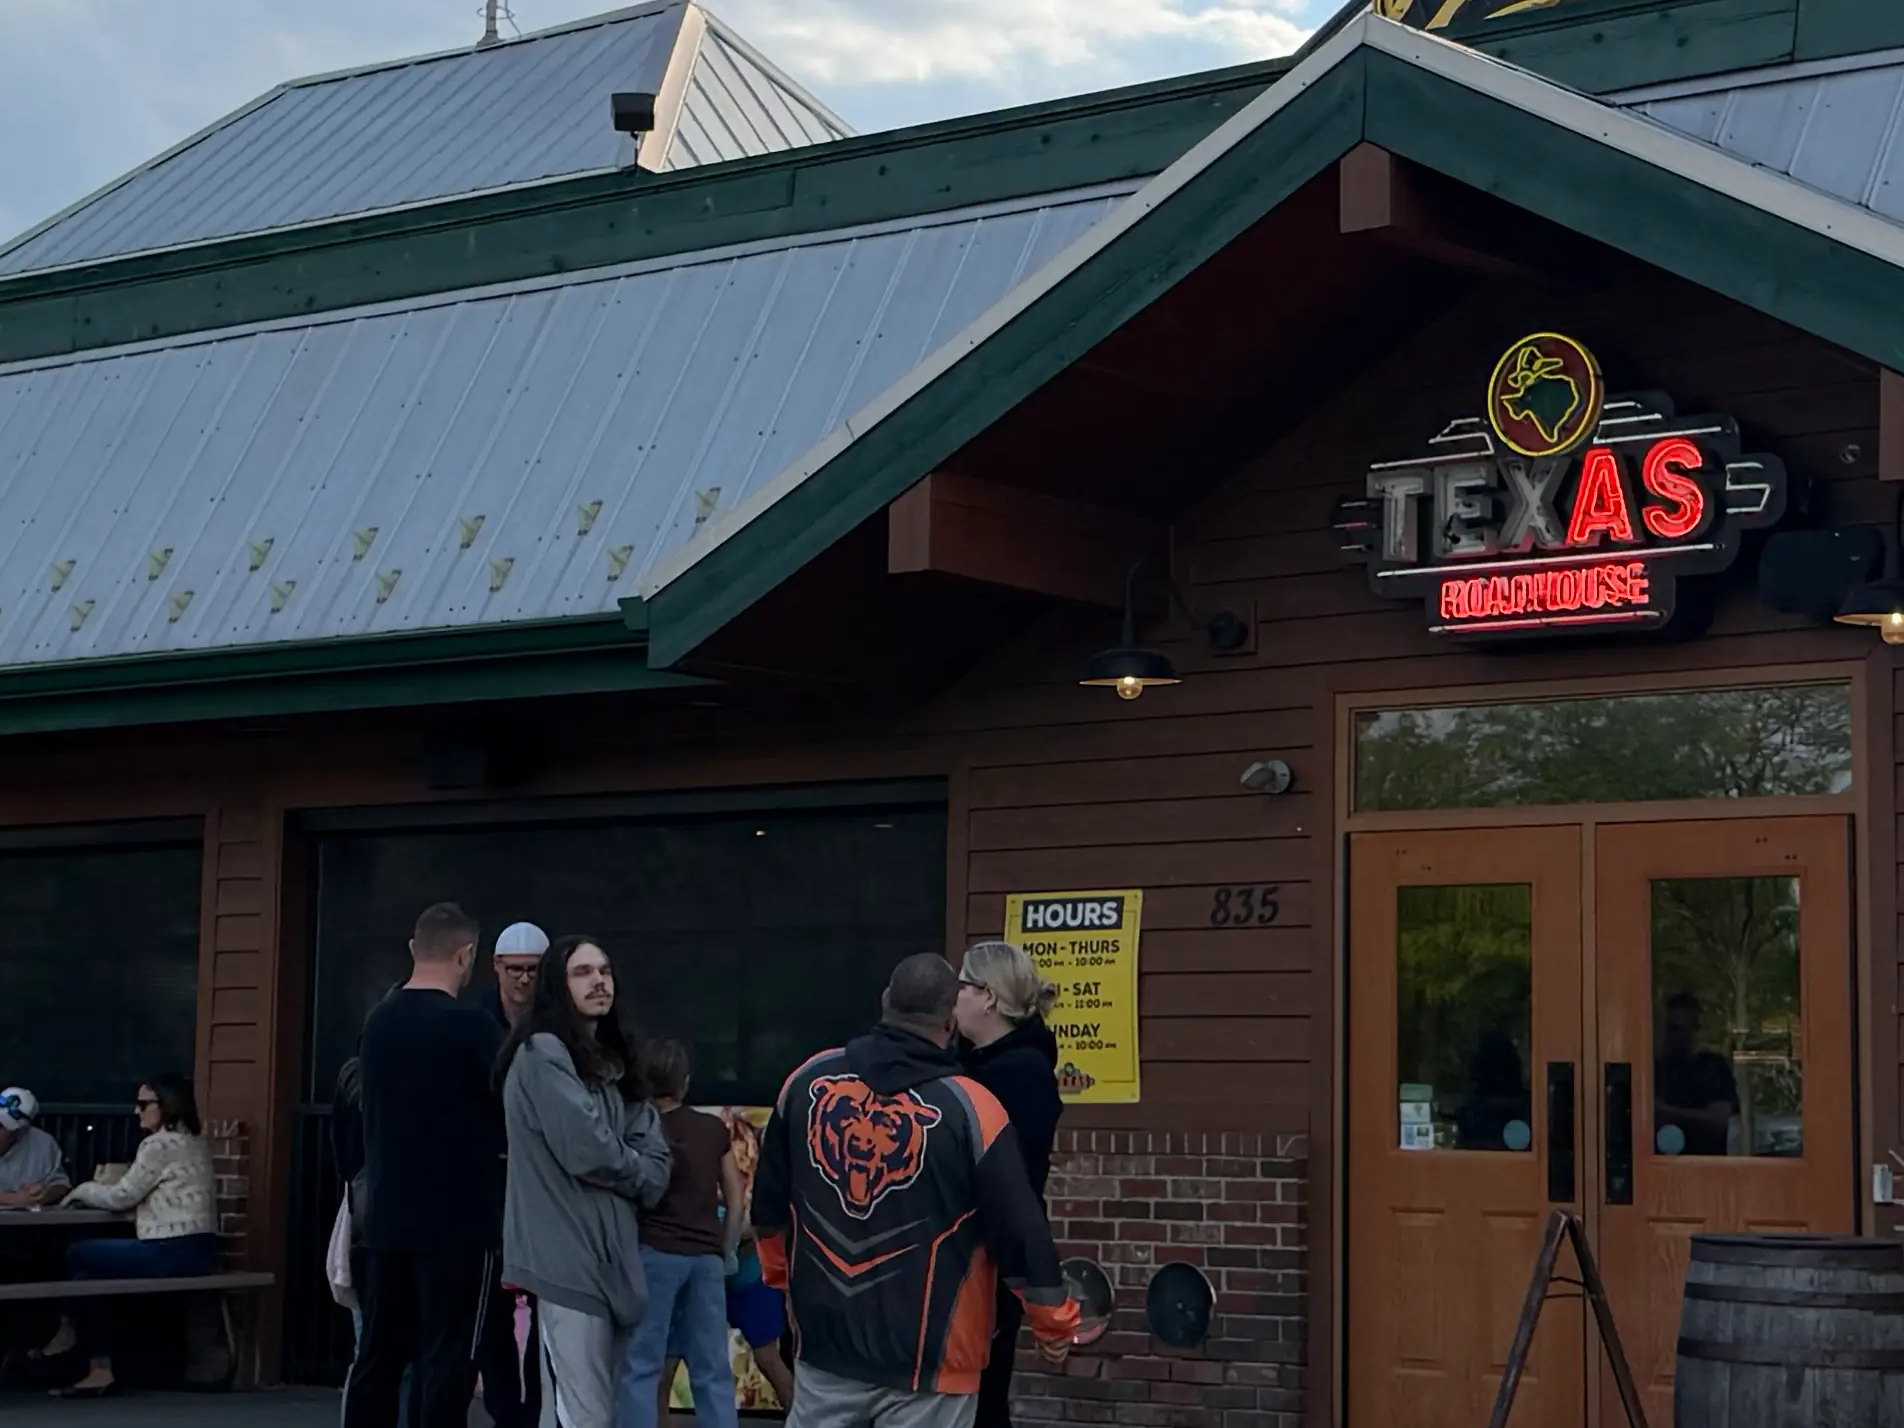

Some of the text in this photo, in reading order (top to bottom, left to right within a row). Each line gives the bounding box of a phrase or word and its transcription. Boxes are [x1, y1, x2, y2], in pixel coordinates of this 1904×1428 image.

[1367, 438, 1705, 562] TEXAS
[1440, 563, 1649, 619] ROADHOUSE
[1026, 901, 1119, 929] HOURS
[1210, 886, 1280, 925] 835
[1069, 939, 1120, 955] THURS
[1072, 981, 1101, 996] SAT
